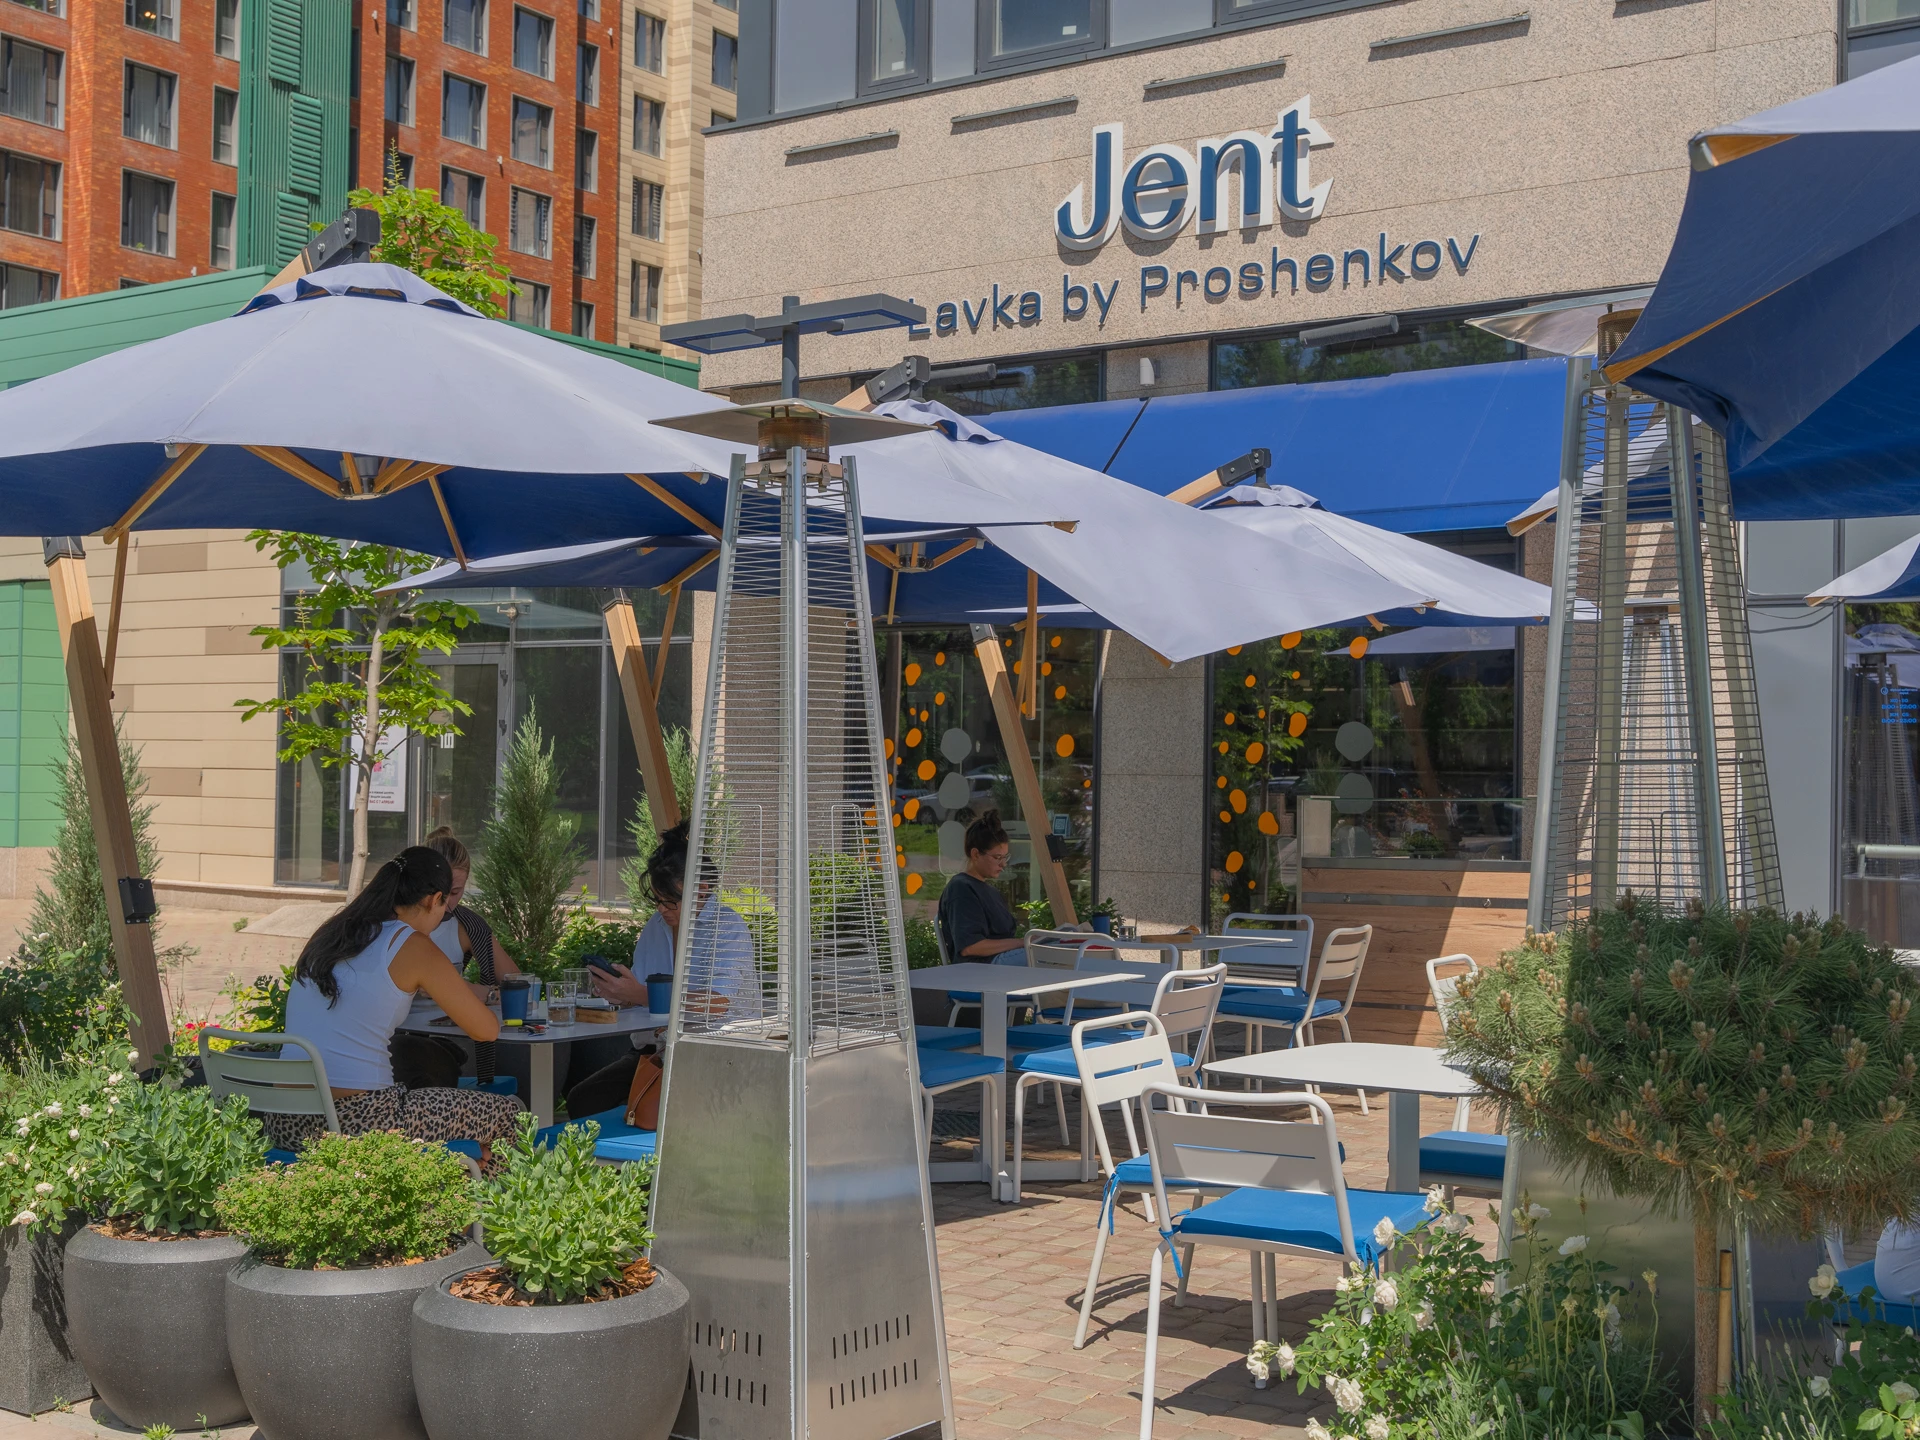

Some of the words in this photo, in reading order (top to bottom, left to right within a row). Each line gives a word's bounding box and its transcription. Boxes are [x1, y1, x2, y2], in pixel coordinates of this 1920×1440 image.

[1055, 96, 1333, 249] Jent
[1063, 274, 1120, 325] by
[1141, 232, 1482, 307] Proshenkov
